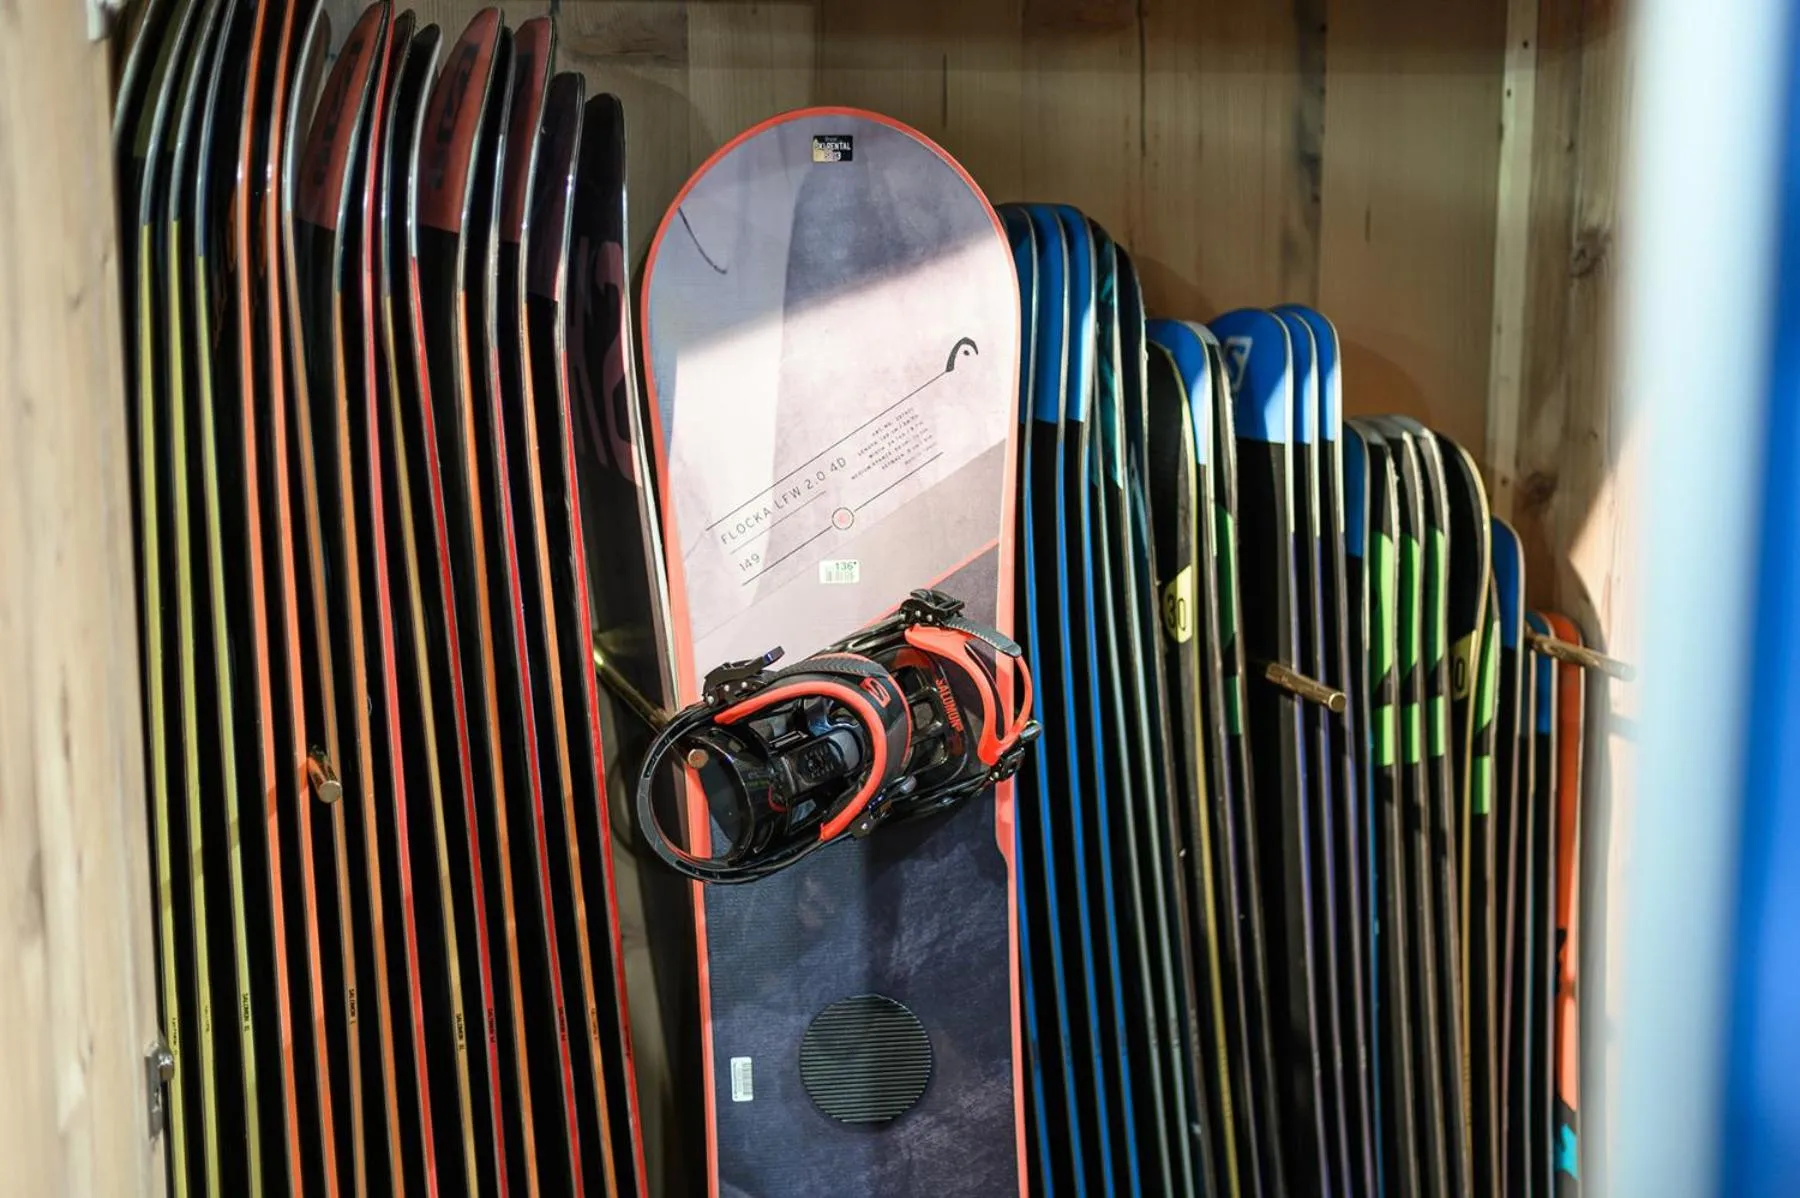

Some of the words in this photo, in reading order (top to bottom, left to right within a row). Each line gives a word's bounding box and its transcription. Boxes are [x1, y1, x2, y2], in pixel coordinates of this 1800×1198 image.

[720, 506, 772, 544] FLOCKA
[774, 486, 801, 509] LFW
[804, 470, 826, 490] 2.0
[831, 456, 847, 473] 4D
[739, 553, 760, 571] 149
[936, 678, 963, 730] SALOMON
